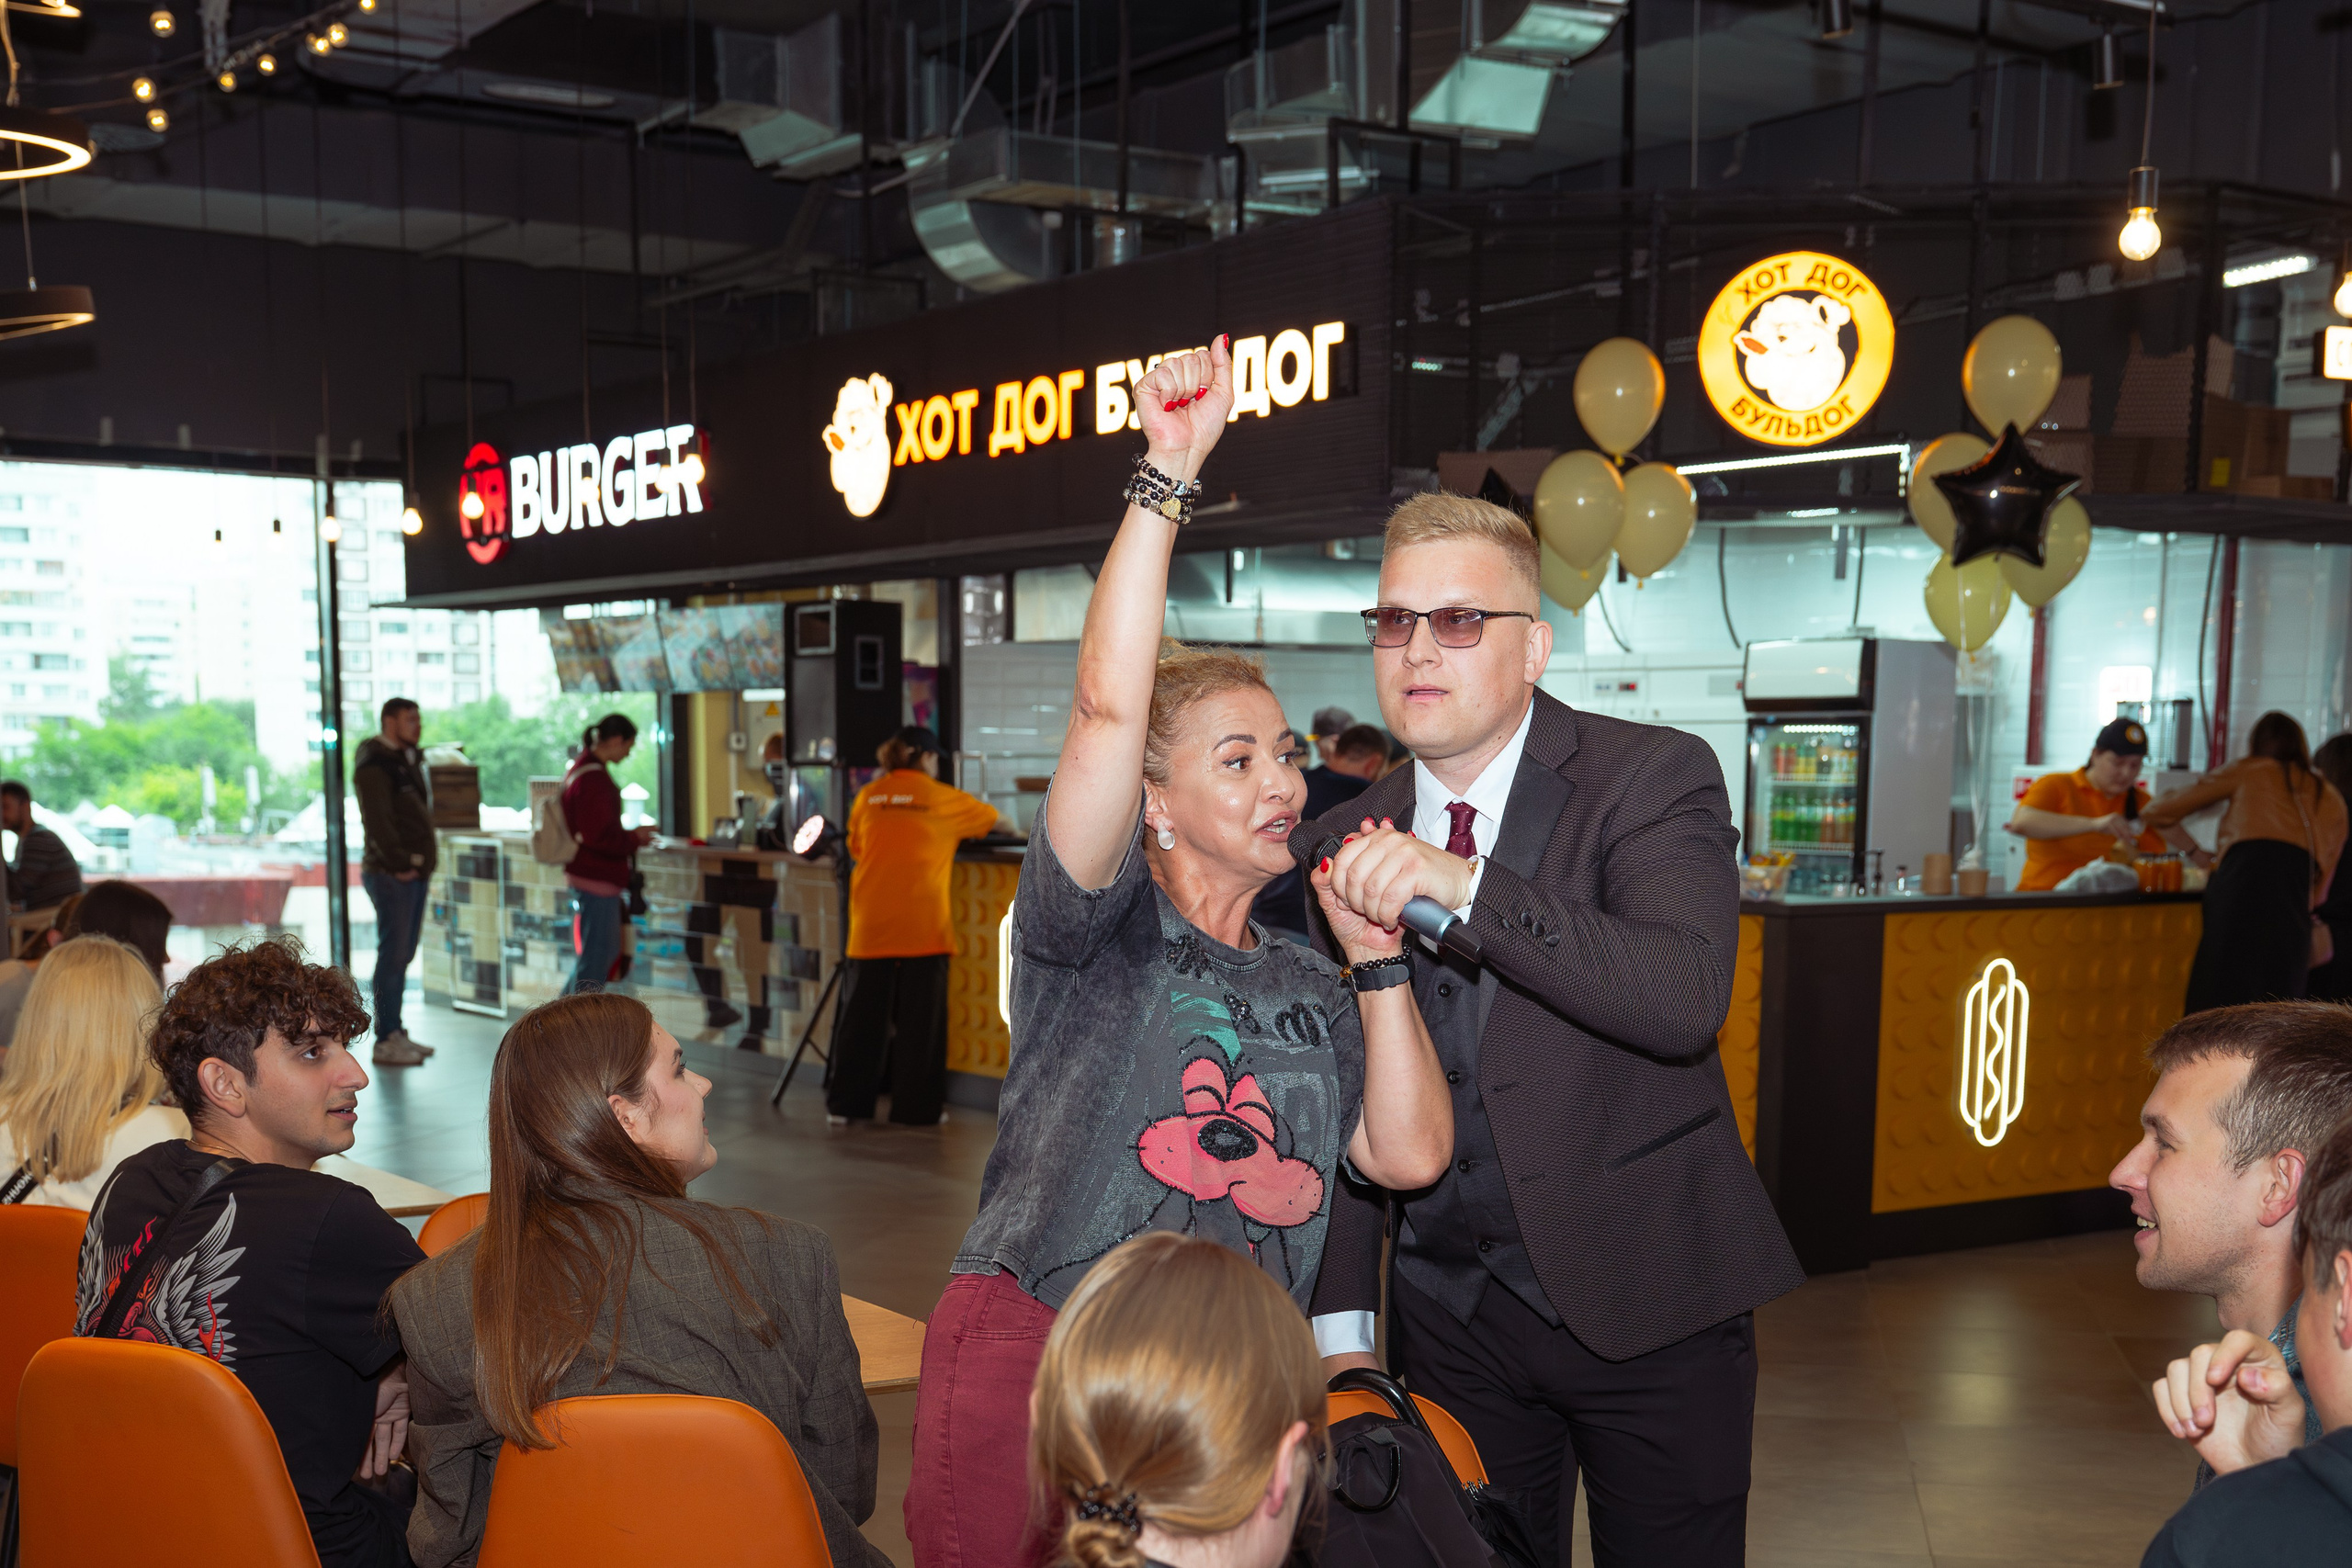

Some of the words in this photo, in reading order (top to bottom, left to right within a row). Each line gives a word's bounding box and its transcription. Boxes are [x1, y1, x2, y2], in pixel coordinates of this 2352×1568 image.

[1736, 263, 1791, 303] ХОТ
[1806, 264, 1867, 299] ДОГ
[893, 389, 979, 467] ХОТ
[988, 369, 1085, 458] ДОГ
[1095, 321, 1346, 435] БУДОГ
[1731, 395, 1855, 436] БУЛЬДОГ
[509, 423, 704, 539] BURGER
